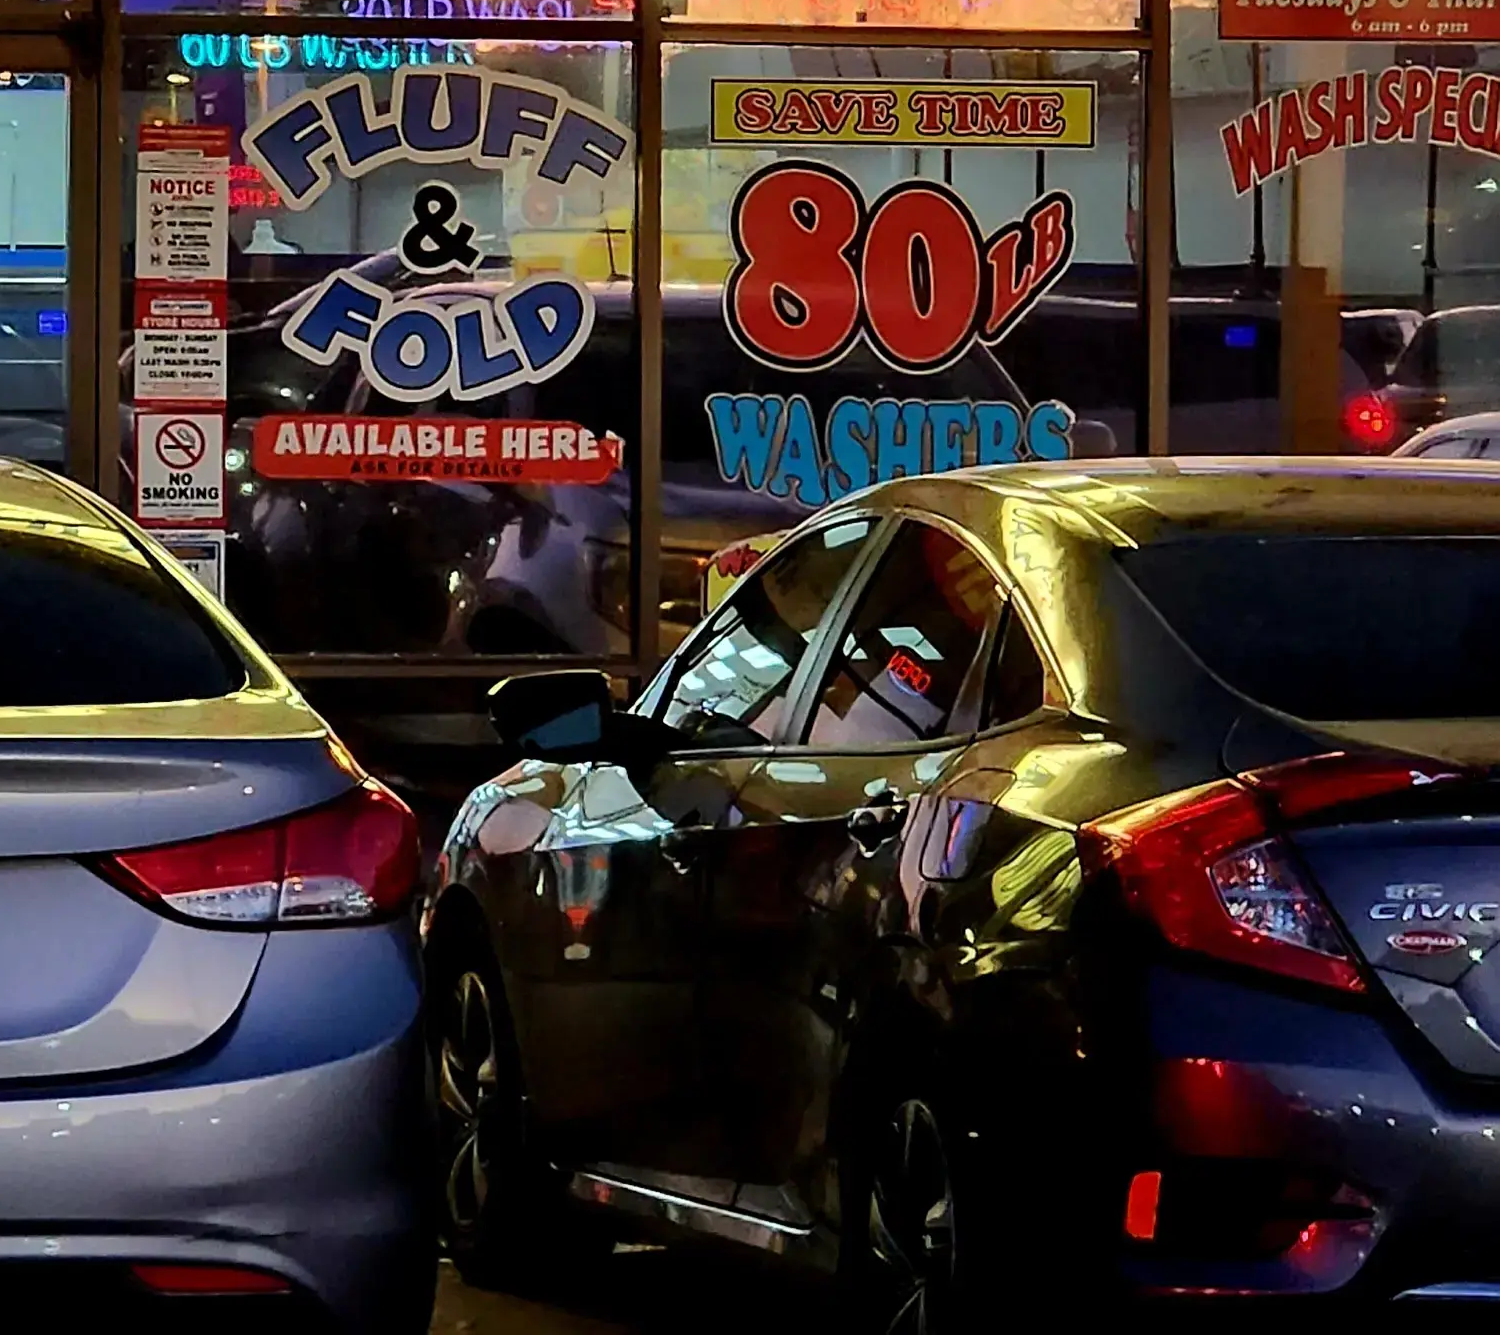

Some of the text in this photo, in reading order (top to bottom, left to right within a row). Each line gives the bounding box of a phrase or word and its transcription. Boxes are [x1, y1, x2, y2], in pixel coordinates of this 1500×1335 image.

[1351, 19, 1363, 32] 6
[1368, 21, 1400, 33] am
[1419, 20, 1430, 32] 6
[1436, 22, 1469, 35] pm
[737, 89, 1066, 137] SAVE TIME
[1220, 65, 1500, 198] WASH SPECI
[248, 70, 630, 202] FLUFF
[150, 178, 215, 195] NOTICE
[403, 184, 480, 269] &
[732, 166, 1066, 365] 80 LB
[293, 276, 585, 392] FOLD
[273, 421, 601, 461] AVAILABLE HERE
[706, 393, 1073, 506] WASHERS
[169, 472, 193, 486] NO
[398, 461, 435, 475] FOR
[443, 462, 523, 476] DETAILS
[141, 486, 219, 500] SMOKING
[1369, 902, 1500, 923] CIVIC
